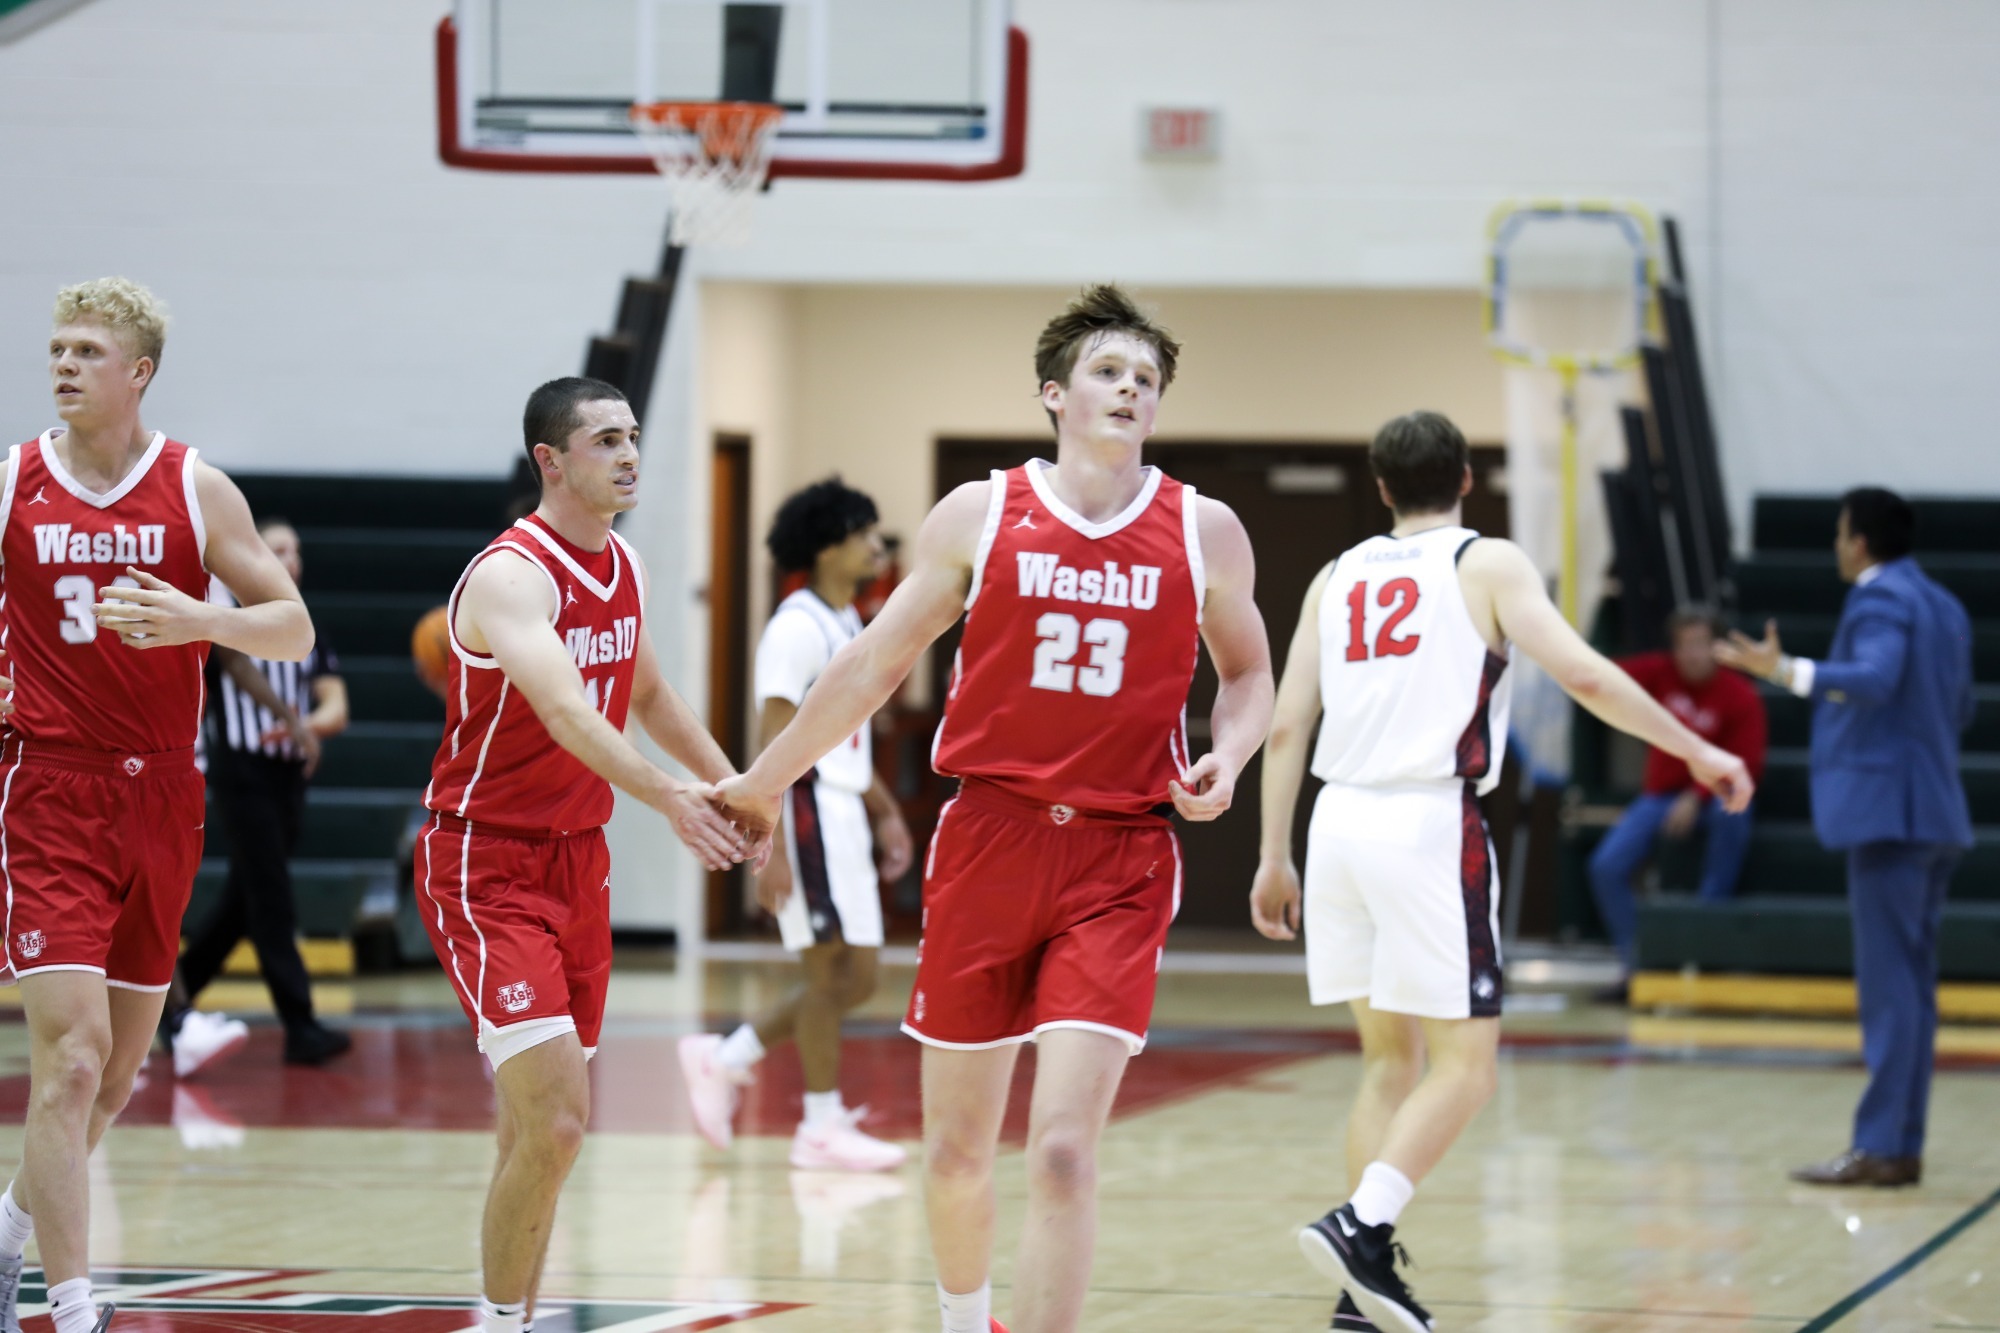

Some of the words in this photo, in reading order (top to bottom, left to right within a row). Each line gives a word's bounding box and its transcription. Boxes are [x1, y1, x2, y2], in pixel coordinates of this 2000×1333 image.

[33, 523, 166, 565] WashU
[1016, 551, 1162, 610] WashU
[1345, 577, 1421, 662] 12
[1030, 612, 1130, 697] 23
[496, 986, 536, 1008] WASH
